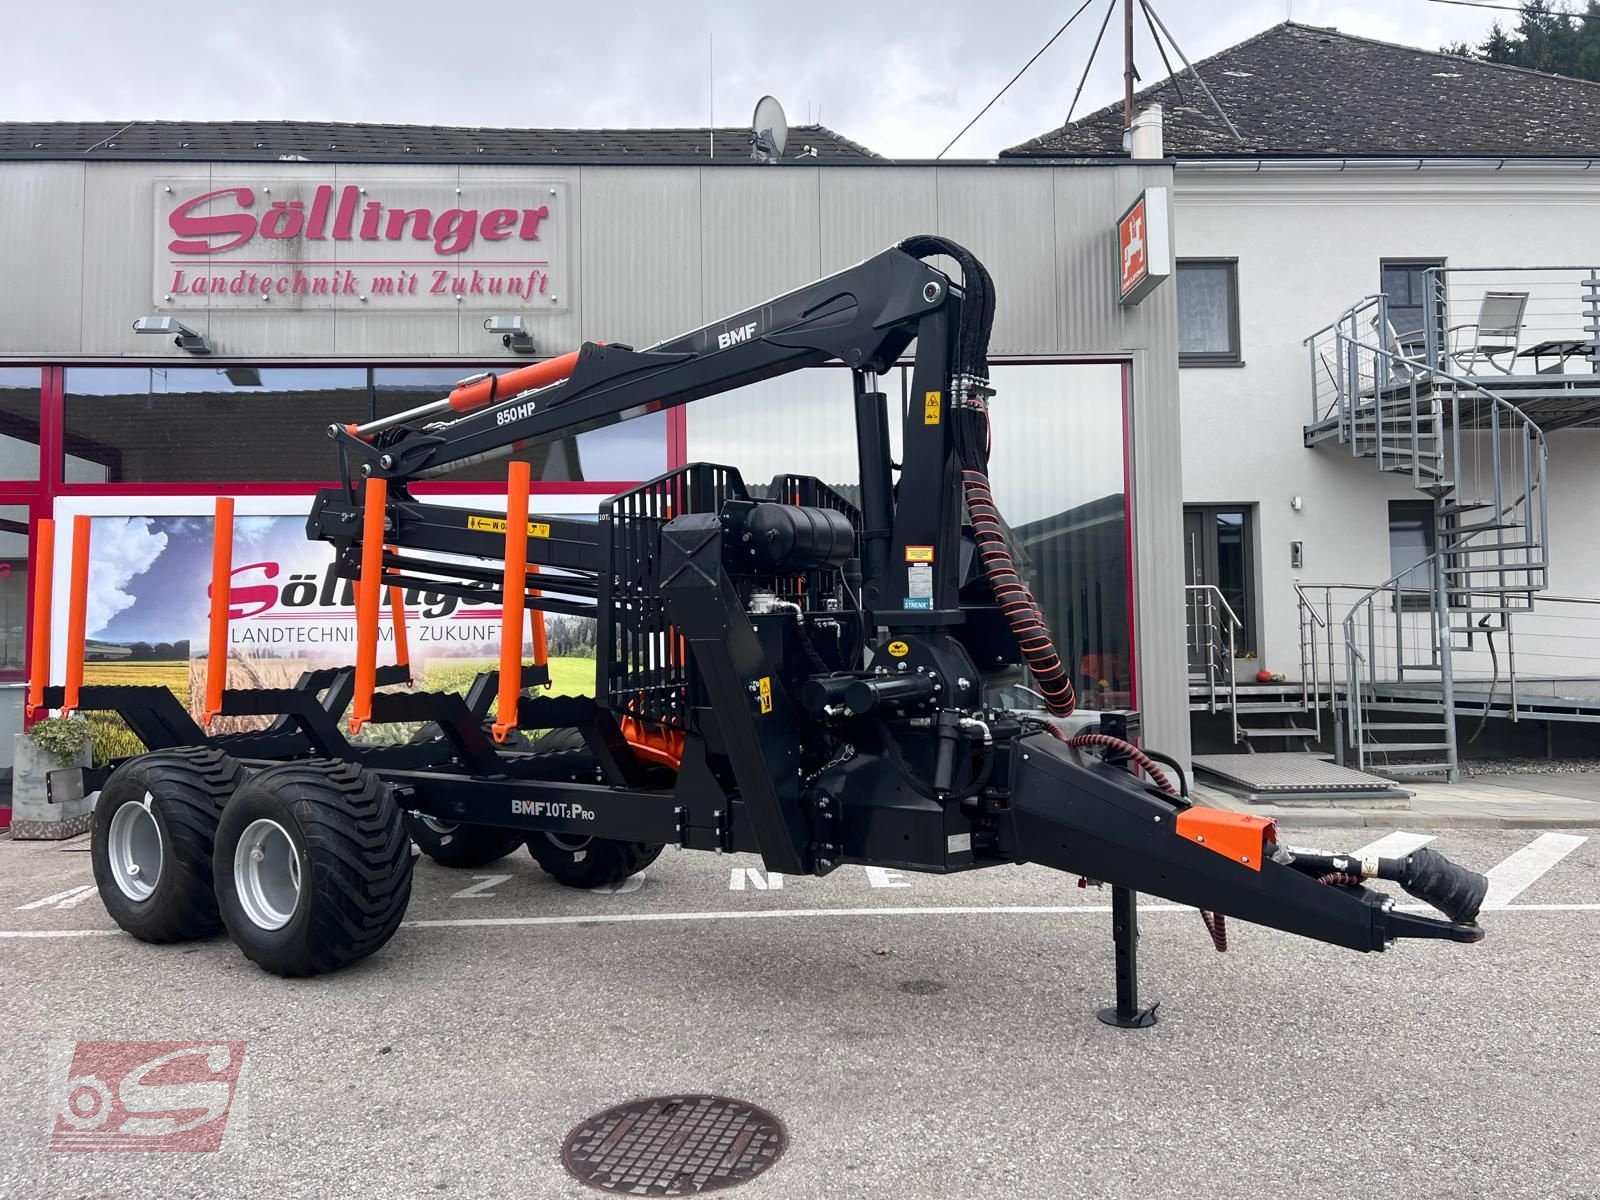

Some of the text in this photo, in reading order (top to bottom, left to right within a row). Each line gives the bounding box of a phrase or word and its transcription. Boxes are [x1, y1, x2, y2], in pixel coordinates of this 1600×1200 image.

[168, 185, 549, 255] Söllinger
[169, 269, 549, 299] Landtechnik mit Zukunft
[717, 322, 757, 350] BMF
[232, 626, 359, 643] LANDTECHNI
[420, 625, 503, 641] ZUKUNF
